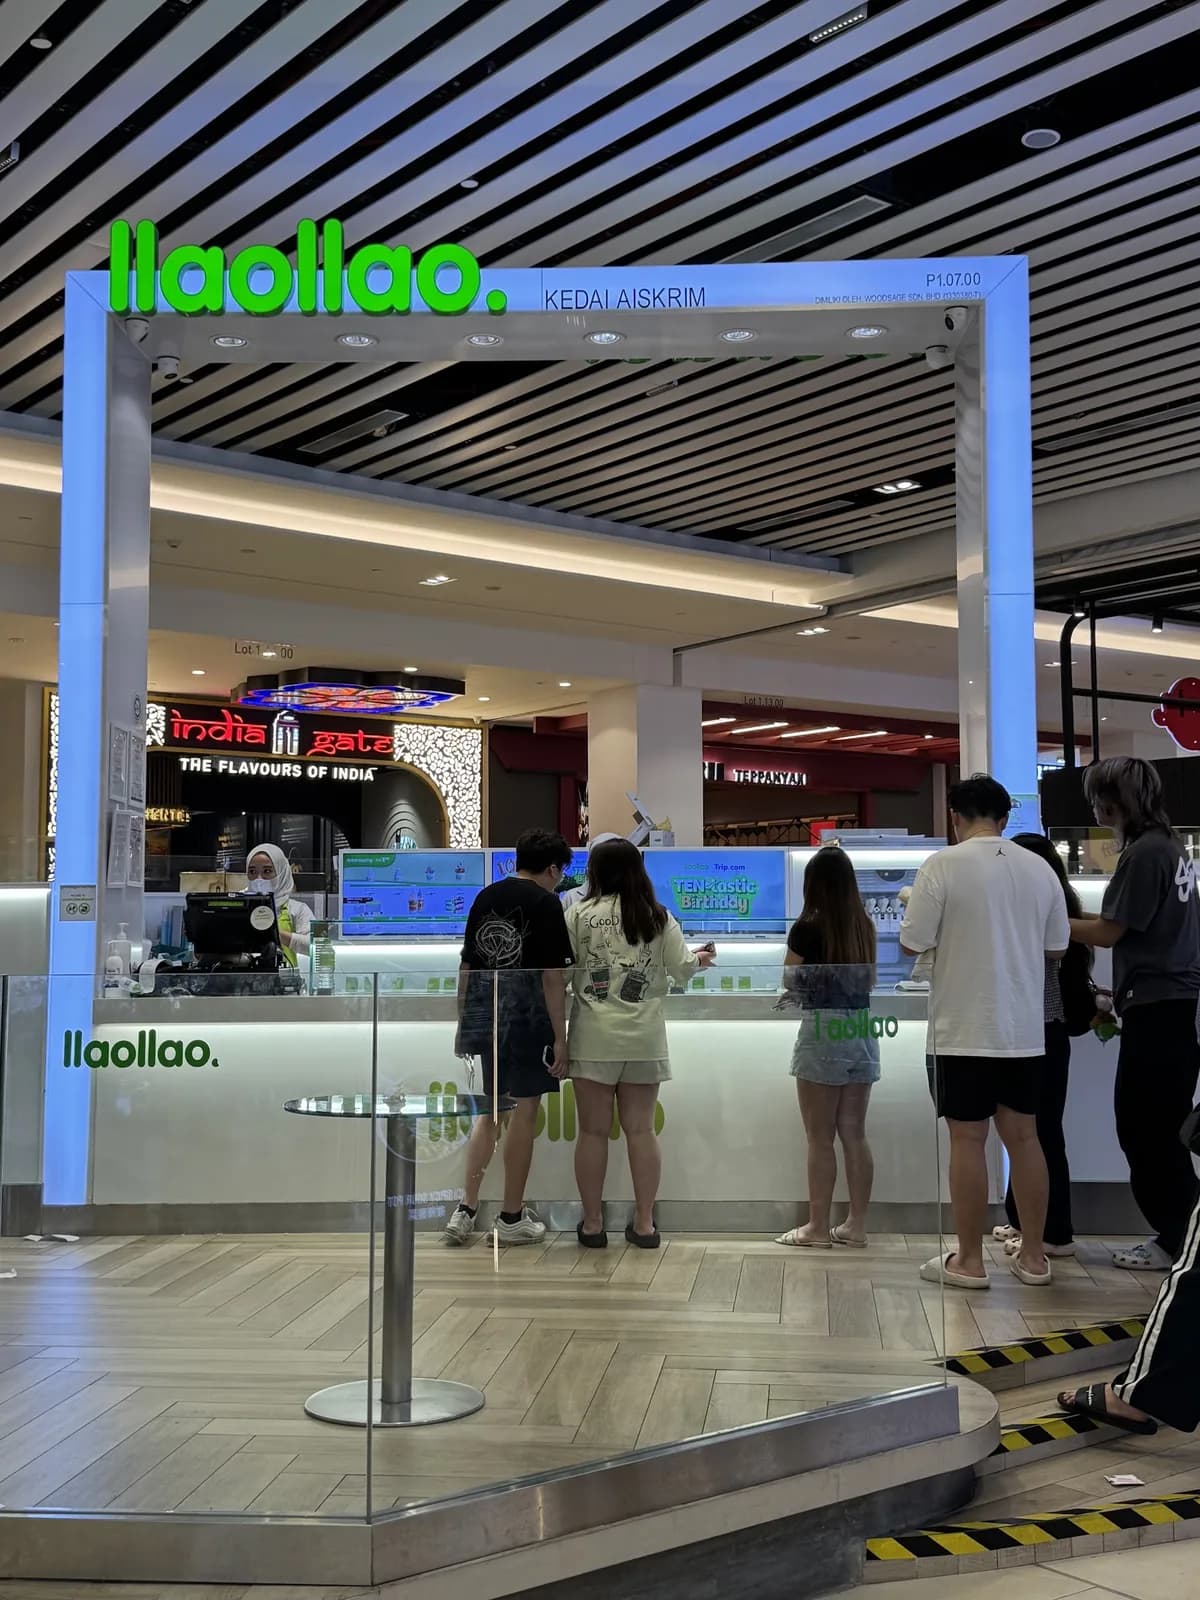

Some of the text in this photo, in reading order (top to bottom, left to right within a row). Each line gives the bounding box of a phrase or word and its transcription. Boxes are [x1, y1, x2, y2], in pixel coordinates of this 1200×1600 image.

[109, 218, 508, 314] llaollao.
[926, 273, 981, 287] P1.07.00
[545, 287, 706, 310] KEDAI AISKRIM
[234, 641, 252, 655] Lot
[170, 709, 395, 757] india gate
[180, 757, 376, 782] THE FLAVOURS OF INDIA
[714, 863, 746, 872] Trip.com
[681, 894, 750, 914] Birthday
[63, 1029, 219, 1068] llaollao.
